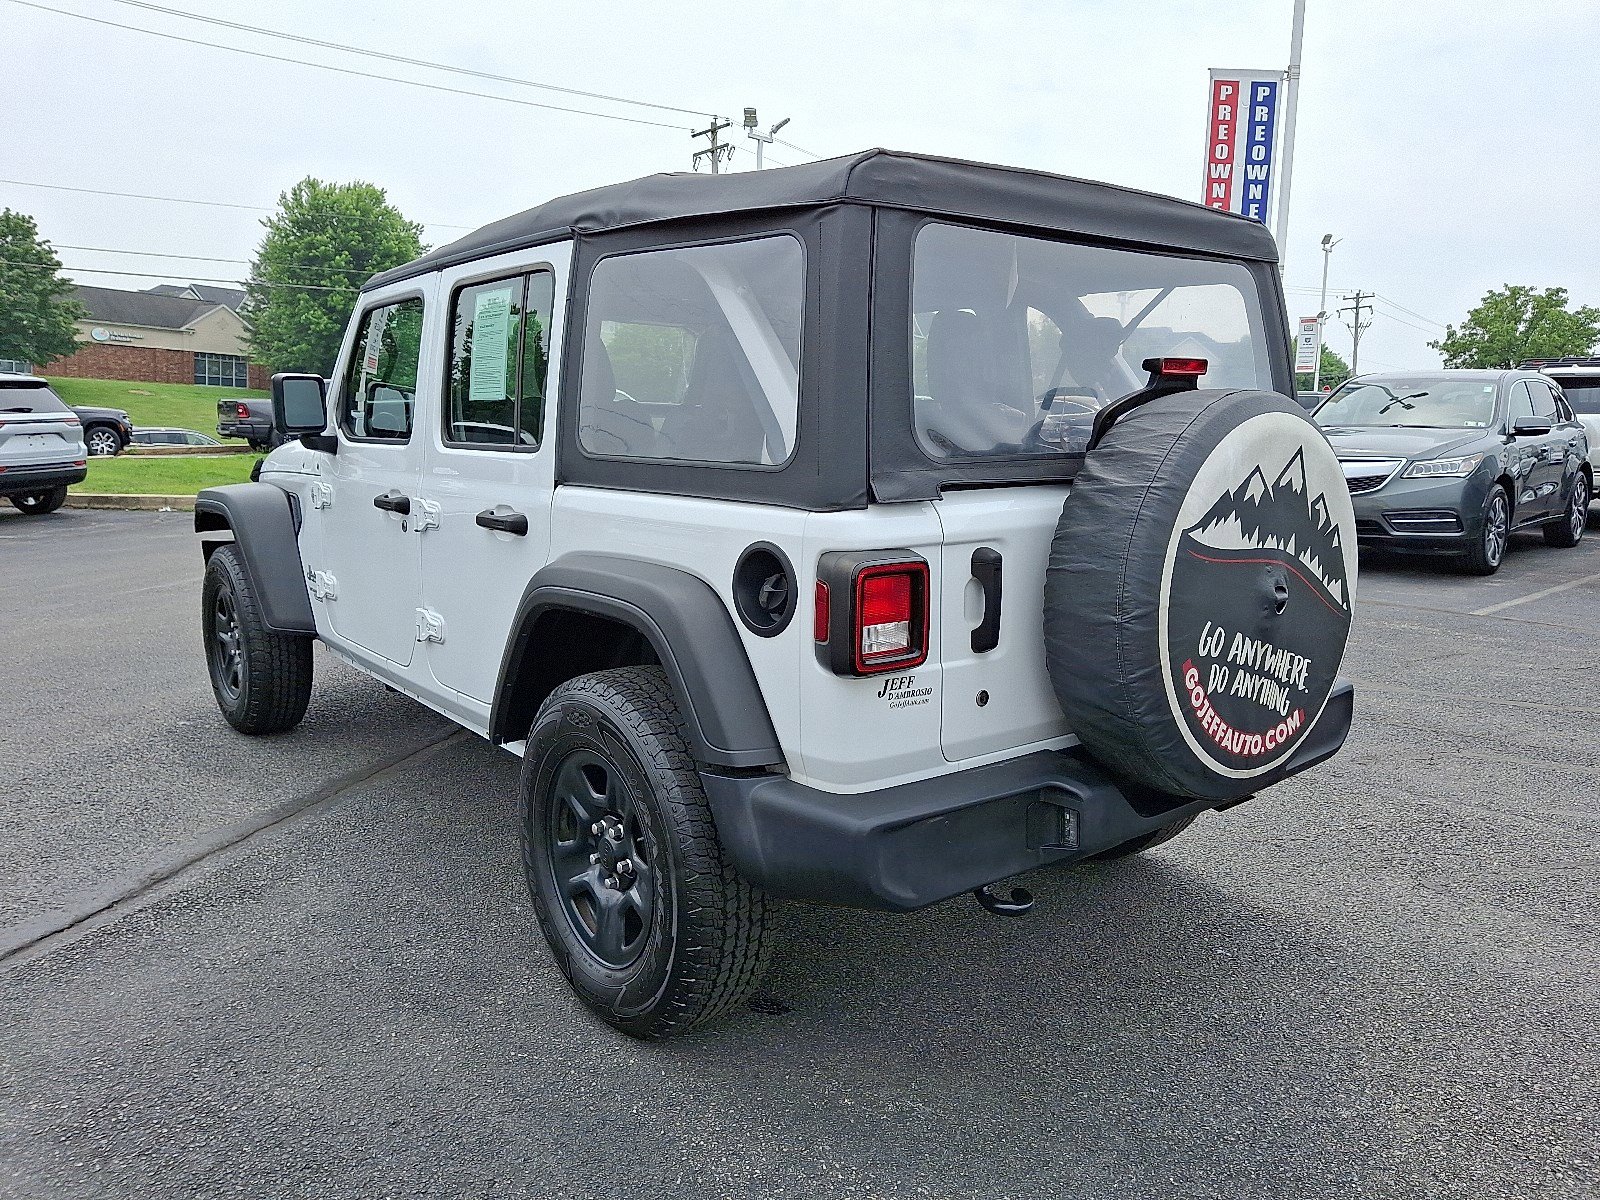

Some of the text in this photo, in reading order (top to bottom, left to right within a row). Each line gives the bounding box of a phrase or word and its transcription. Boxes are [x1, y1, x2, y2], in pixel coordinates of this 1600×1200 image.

[1198, 620, 1312, 694] GO ANYWHERE.
[877, 675, 916, 698] JEFF
[888, 687, 933, 701] D'AMBROSIO
[1185, 667, 1301, 755] GOJEFFAUTO.COM
[1207, 663, 1291, 717] DO ANYTHING
